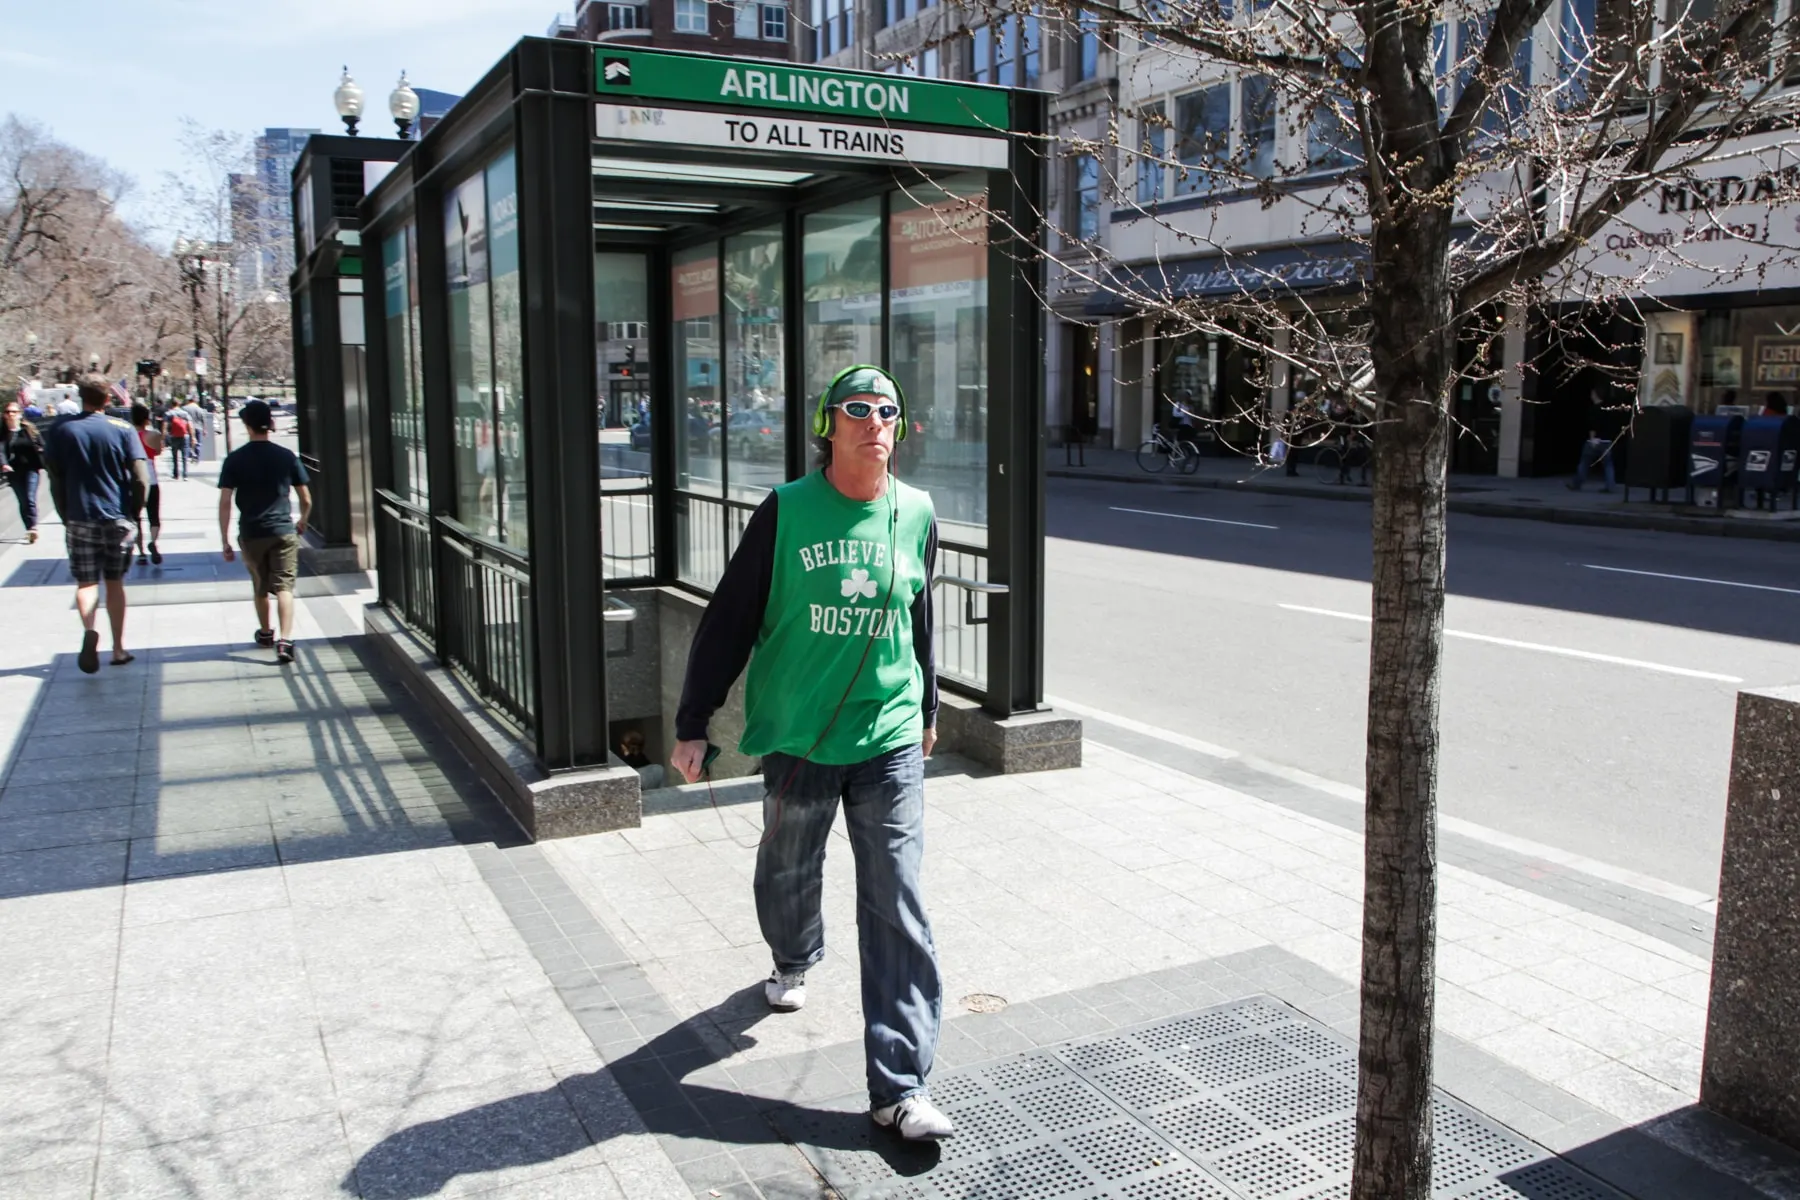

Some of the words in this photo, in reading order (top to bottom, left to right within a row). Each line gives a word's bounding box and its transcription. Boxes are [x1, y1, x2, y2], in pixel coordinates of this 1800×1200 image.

[719, 67, 910, 114] ARLINGTON
[724, 120, 759, 143] TO
[766, 124, 812, 147] ALL
[818, 128, 905, 155] TRAINS
[1606, 231, 1673, 251] Custom
[1178, 268, 1246, 292] PAPER
[799, 539, 886, 572] BELIEVE
[809, 603, 900, 638] BOSTON
